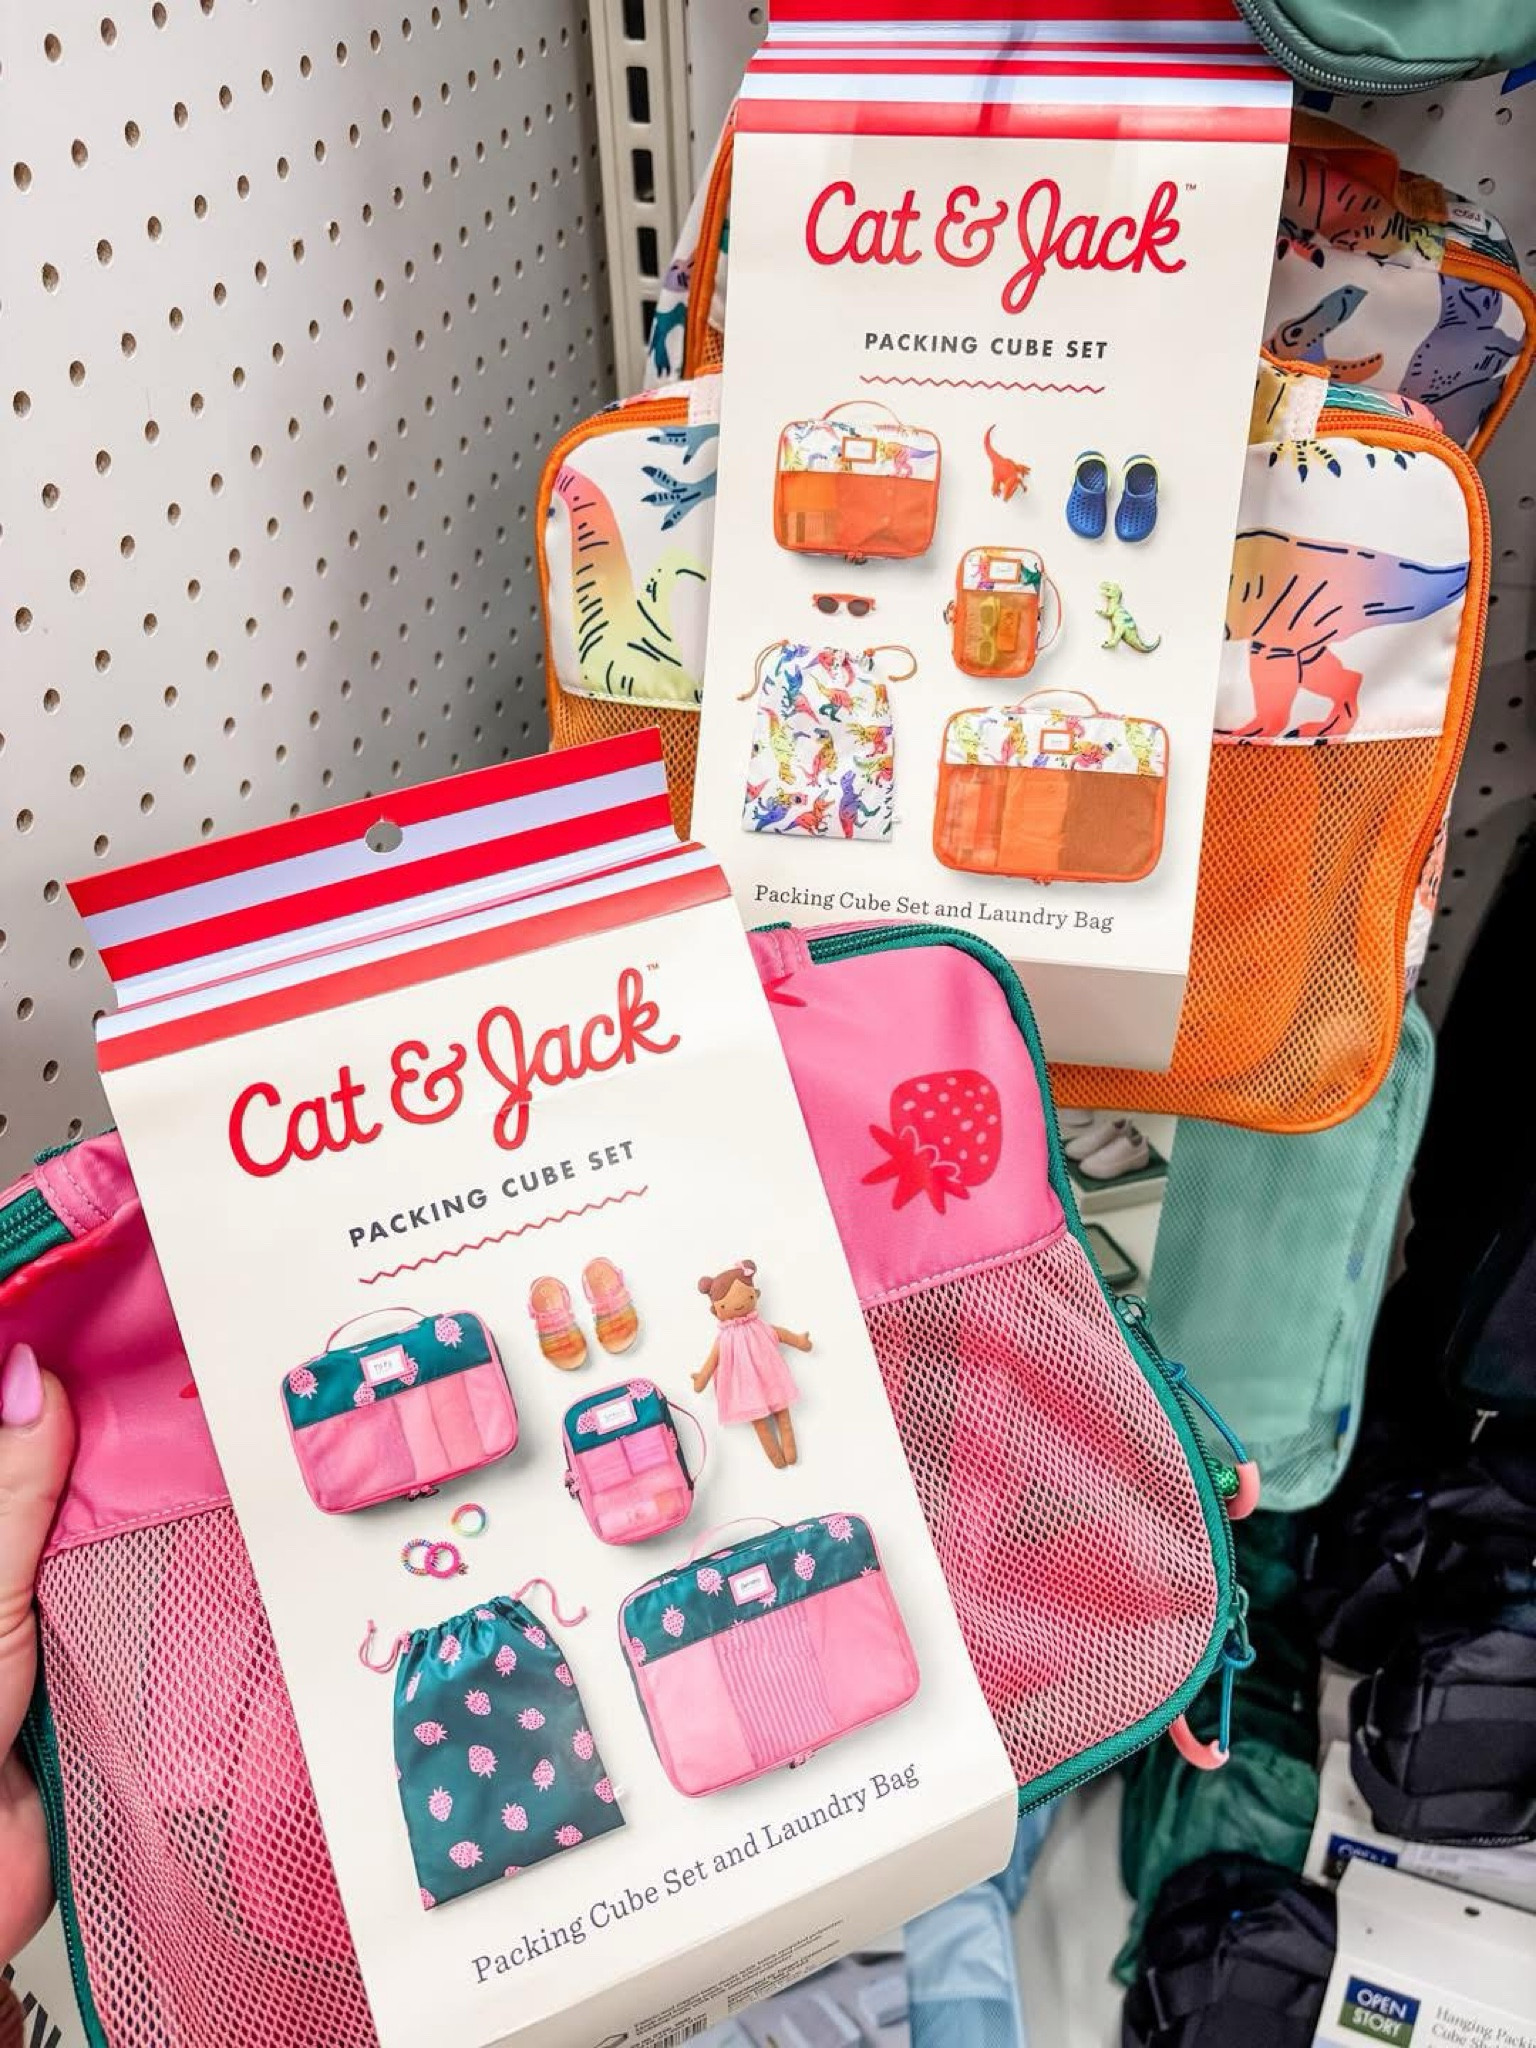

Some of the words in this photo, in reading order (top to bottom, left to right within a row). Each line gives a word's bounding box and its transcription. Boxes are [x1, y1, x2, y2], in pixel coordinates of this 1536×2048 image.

[804, 180, 922, 266] Cat
[933, 184, 1009, 268] &
[1001, 178, 1187, 315] Jack
[864, 332, 978, 355] PACKING
[990, 337, 1054, 358] CUBE
[1066, 340, 1109, 360] SET
[754, 885, 835, 911] Packing
[840, 891, 891, 913] Cube
[896, 896, 930, 916] Set
[935, 901, 972, 920] and
[978, 903, 1069, 930] Laundry
[1074, 911, 1115, 934] Bag
[227, 1065, 383, 1178] Cat
[390, 1040, 468, 1125] &
[476, 967, 681, 1150] Jack
[348, 1189, 488, 1248] PACKING
[501, 1160, 576, 1199] CUBE
[588, 1140, 635, 1172] SET
[471, 1916, 588, 1984] Packing
[589, 1886, 660, 1930] Cube
[663, 1860, 708, 1897] Set
[713, 1831, 761, 1875] and
[761, 1788, 867, 1850] Laundry
[869, 1763, 921, 1800] Bag
[1353, 2007, 1403, 2038] STORY
[1356, 1988, 1407, 2020] OPEN
